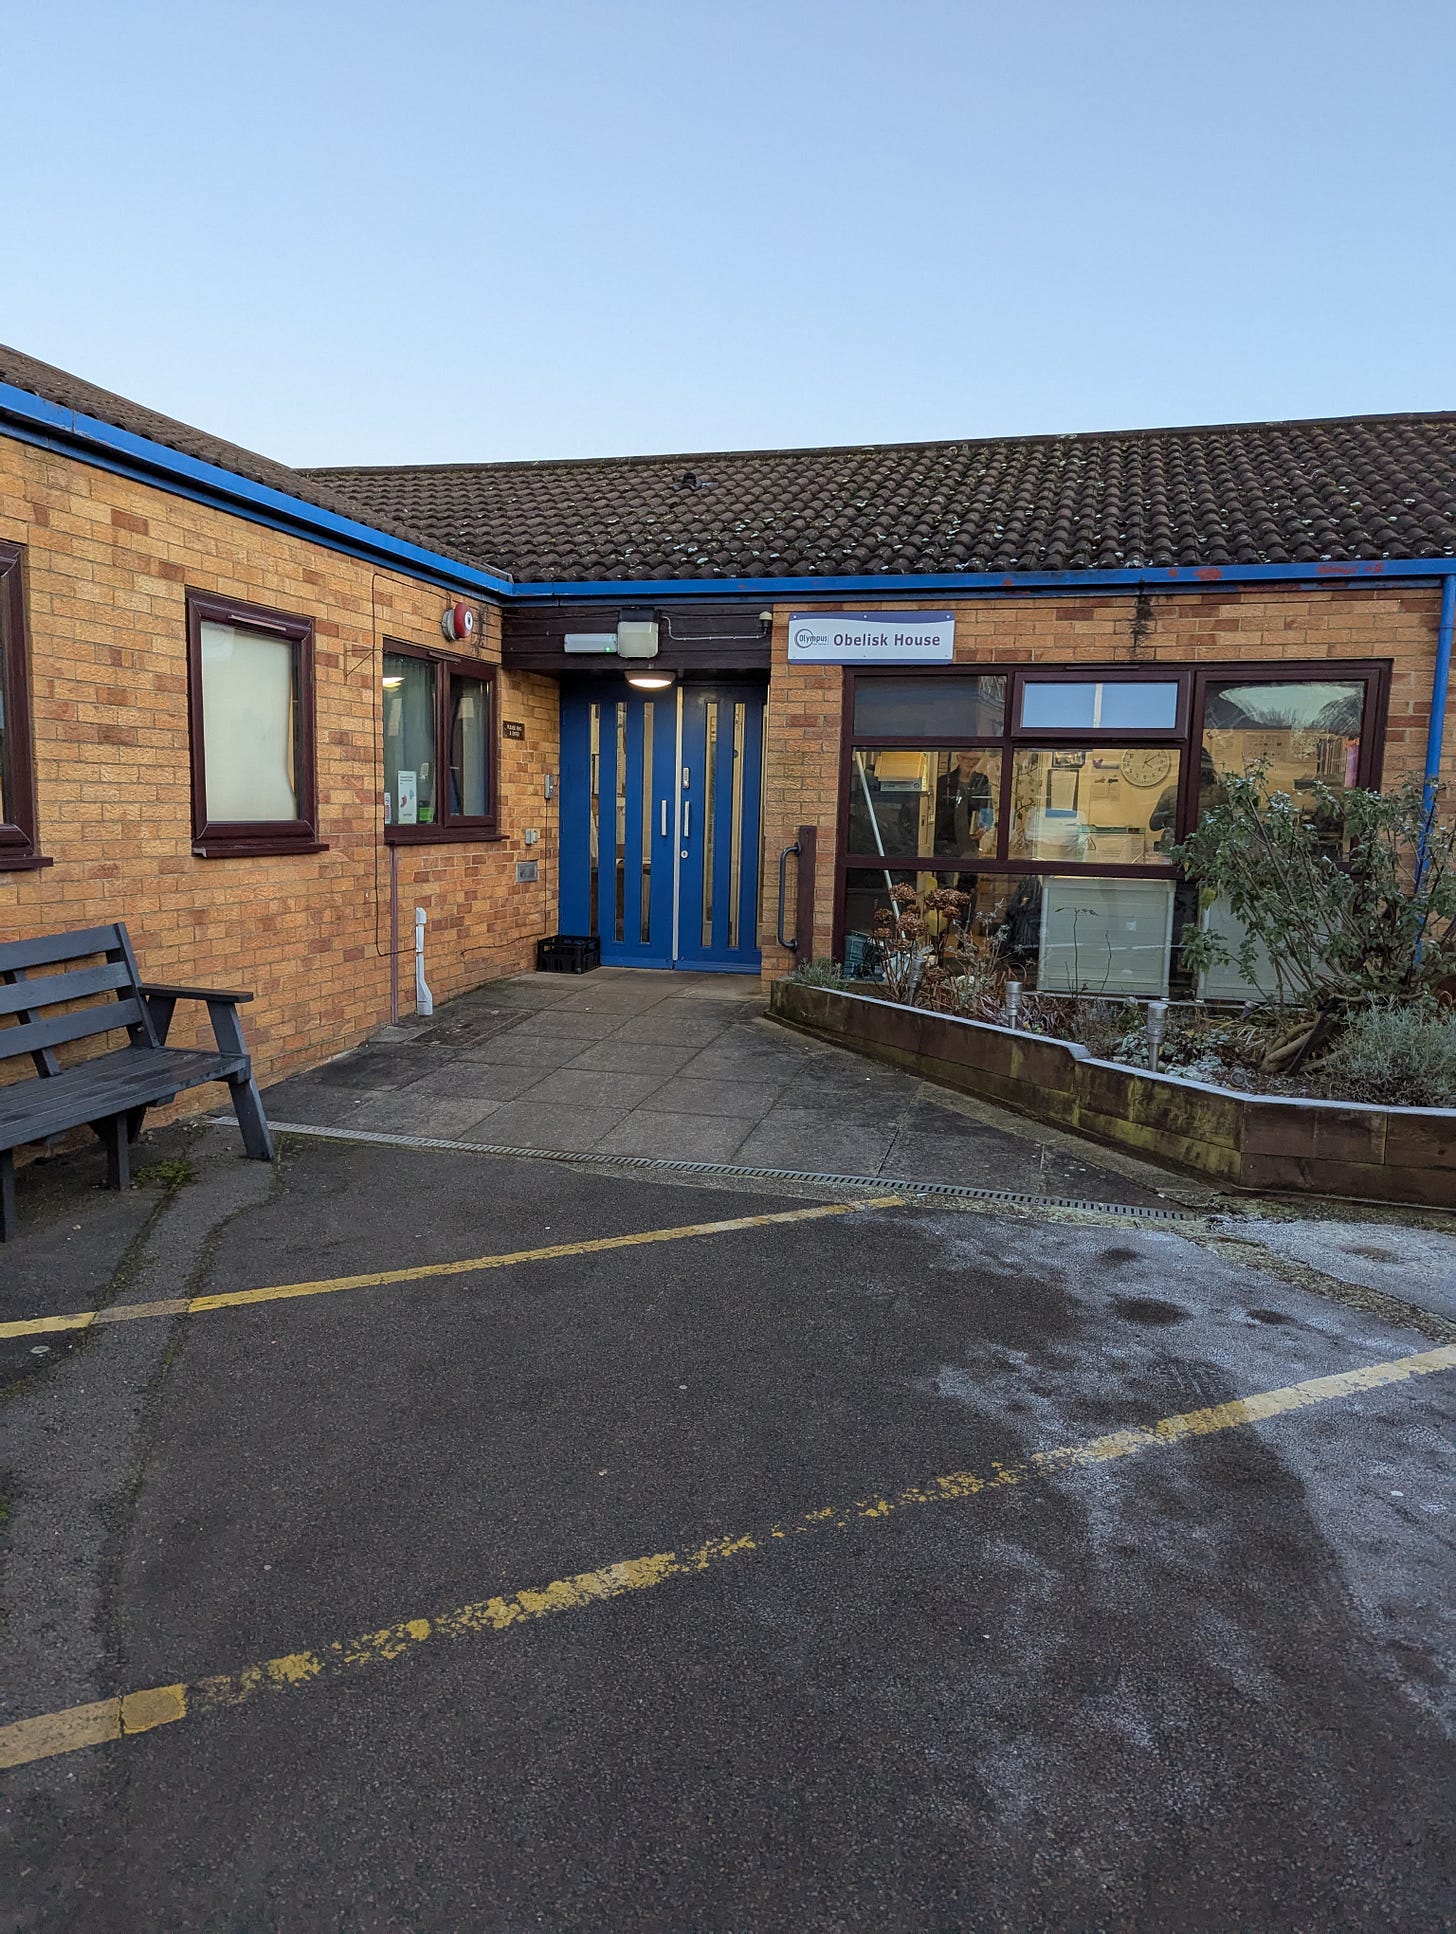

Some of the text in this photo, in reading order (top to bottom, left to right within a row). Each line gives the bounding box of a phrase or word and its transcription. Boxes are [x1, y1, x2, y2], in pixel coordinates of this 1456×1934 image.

[799, 634, 828, 643] Olympus
[834, 634, 940, 646] Obelisk House
